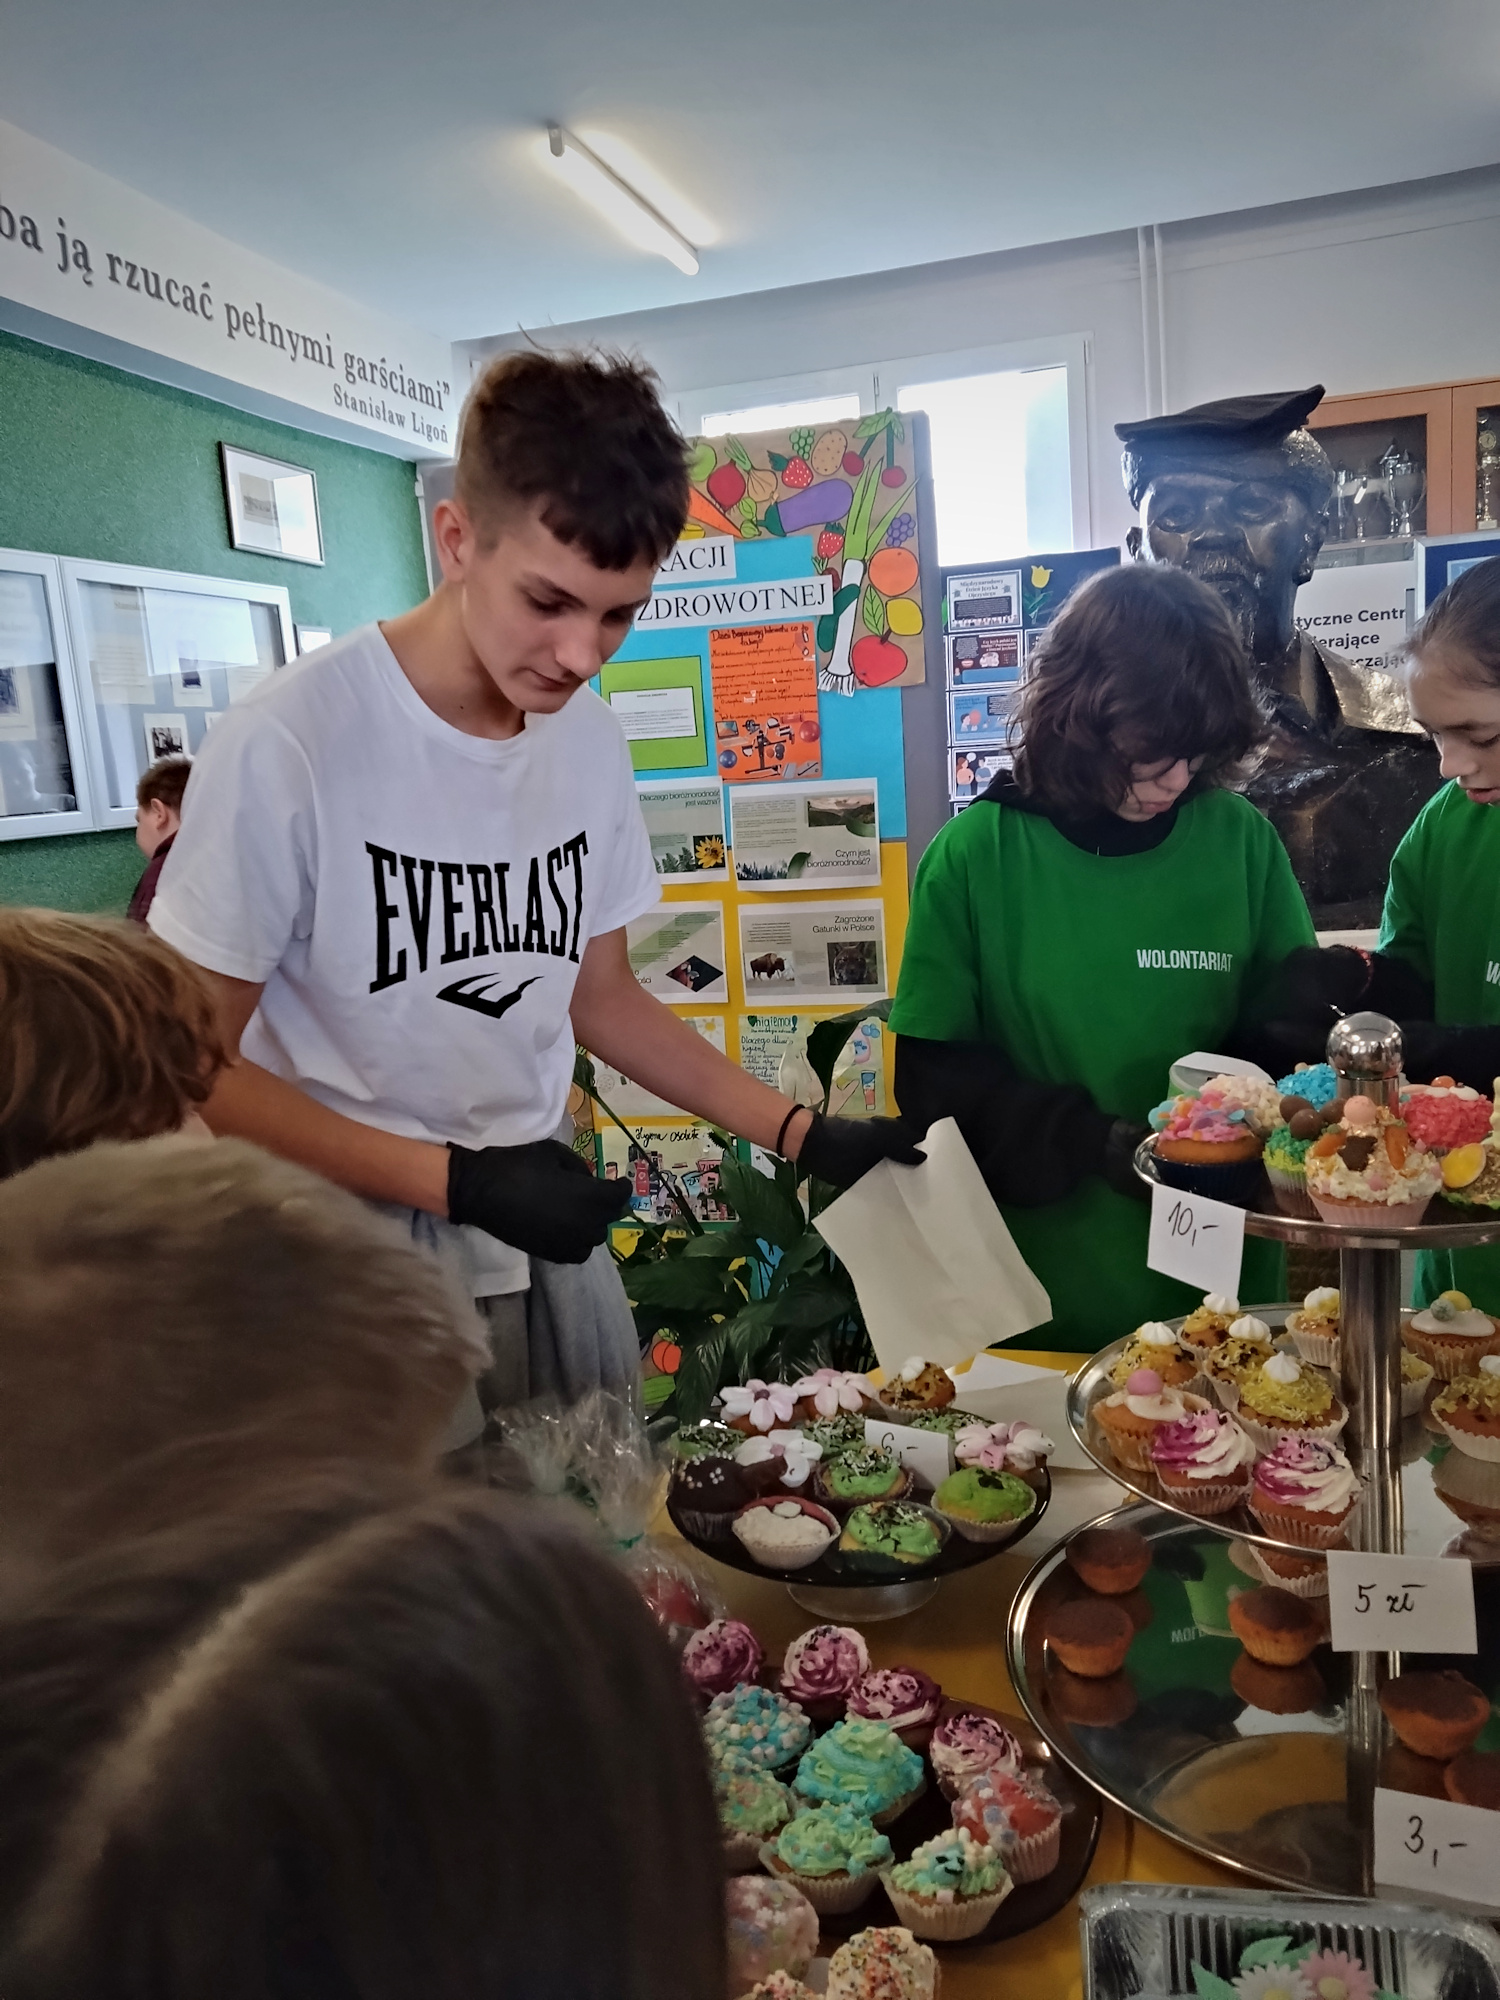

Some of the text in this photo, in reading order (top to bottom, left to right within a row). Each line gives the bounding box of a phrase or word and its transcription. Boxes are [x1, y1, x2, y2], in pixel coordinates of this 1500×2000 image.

[56, 217, 93, 286] ją
[105, 252, 214, 321] rzucać
[224, 302, 336, 370] pełnymi
[333, 382, 448, 443] Stanisław Ligoń
[637, 583, 826, 621] ZDROWOTNEJ
[640, 793, 668, 802] Dlaczego
[806, 858, 871, 868] bioróżnorodność?
[835, 849, 870, 858] Czym jest
[364, 830, 589, 994] EVERLAST
[834, 915, 875, 925] Zagrożone
[812, 924, 841, 934] Gatunki
[850, 923, 875, 932] Polsce
[1137, 949, 1233, 972] WOLONTARIAT
[1354, 1583, 1377, 1614] 5
